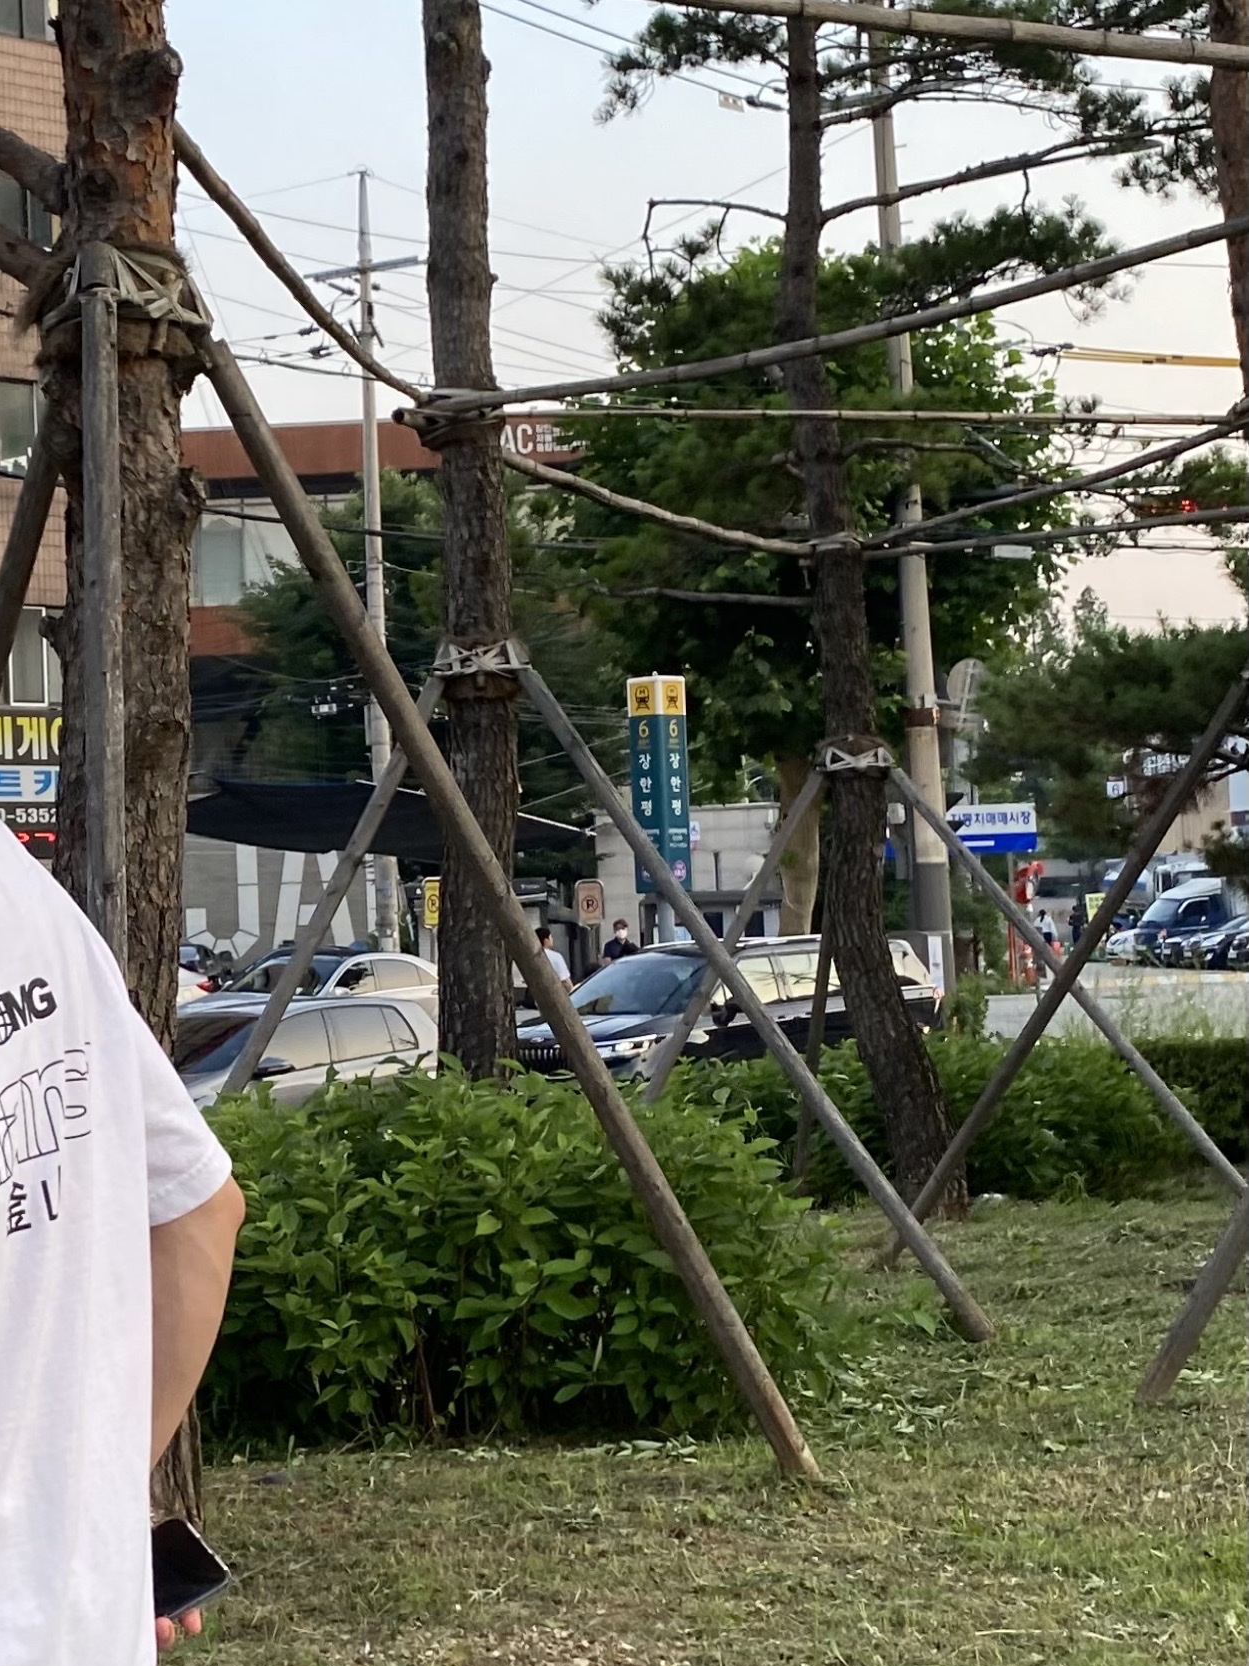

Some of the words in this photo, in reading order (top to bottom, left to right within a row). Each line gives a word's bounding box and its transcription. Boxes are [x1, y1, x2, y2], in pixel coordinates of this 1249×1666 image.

[638, 719, 649, 738] 6
[669, 718, 679, 738] 6
[638, 753, 652, 816] 장한평
[669, 752, 681, 816] 장한평
